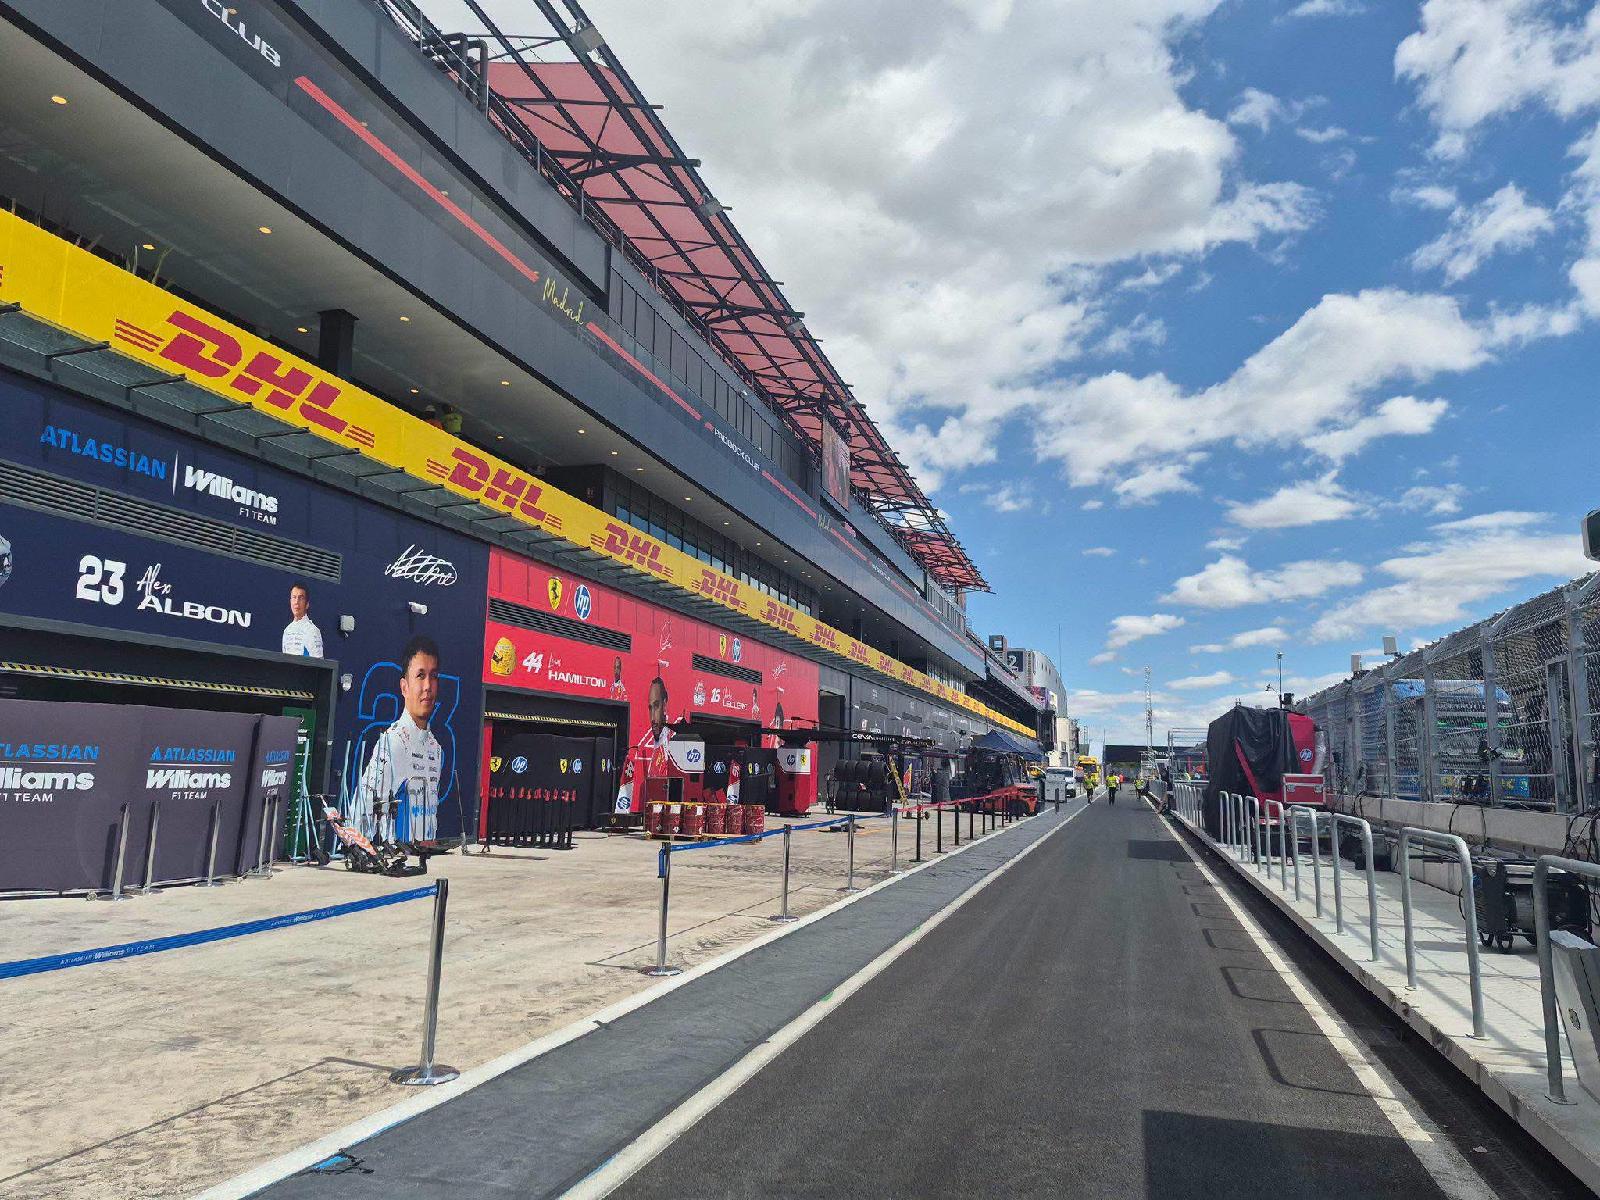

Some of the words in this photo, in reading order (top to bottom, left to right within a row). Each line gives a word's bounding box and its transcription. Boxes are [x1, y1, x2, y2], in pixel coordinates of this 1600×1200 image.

[542, 277, 584, 325] Madrid
[159, 310, 350, 434] DHL
[40, 424, 167, 481] ATLASSIAN
[184, 465, 279, 514] Williams
[447, 446, 548, 522] DHL
[239, 507, 250, 518] F1
[253, 510, 277, 526] TEAM
[604, 522, 665, 574] DHL
[76, 554, 127, 606] 23
[136, 562, 173, 598] Alex
[700, 568, 742, 609] DHL
[136, 594, 252, 629] ALBON
[575, 586, 590, 619] hp
[765, 600, 797, 632] DHL
[522, 651, 544, 674] 44
[548, 669, 608, 688] HAMILTON
[710, 687, 721, 703] 16
[0, 743, 100, 760] LASSIAN
[164, 747, 237, 763] ATLASSIAN
[512, 756, 528, 773] hp
[687, 749, 701, 763] hp
[146, 769, 232, 789] Williams
[14, 793, 54, 802] TEAM
[172, 791, 182, 800] F1
[183, 791, 208, 800] TEAM
